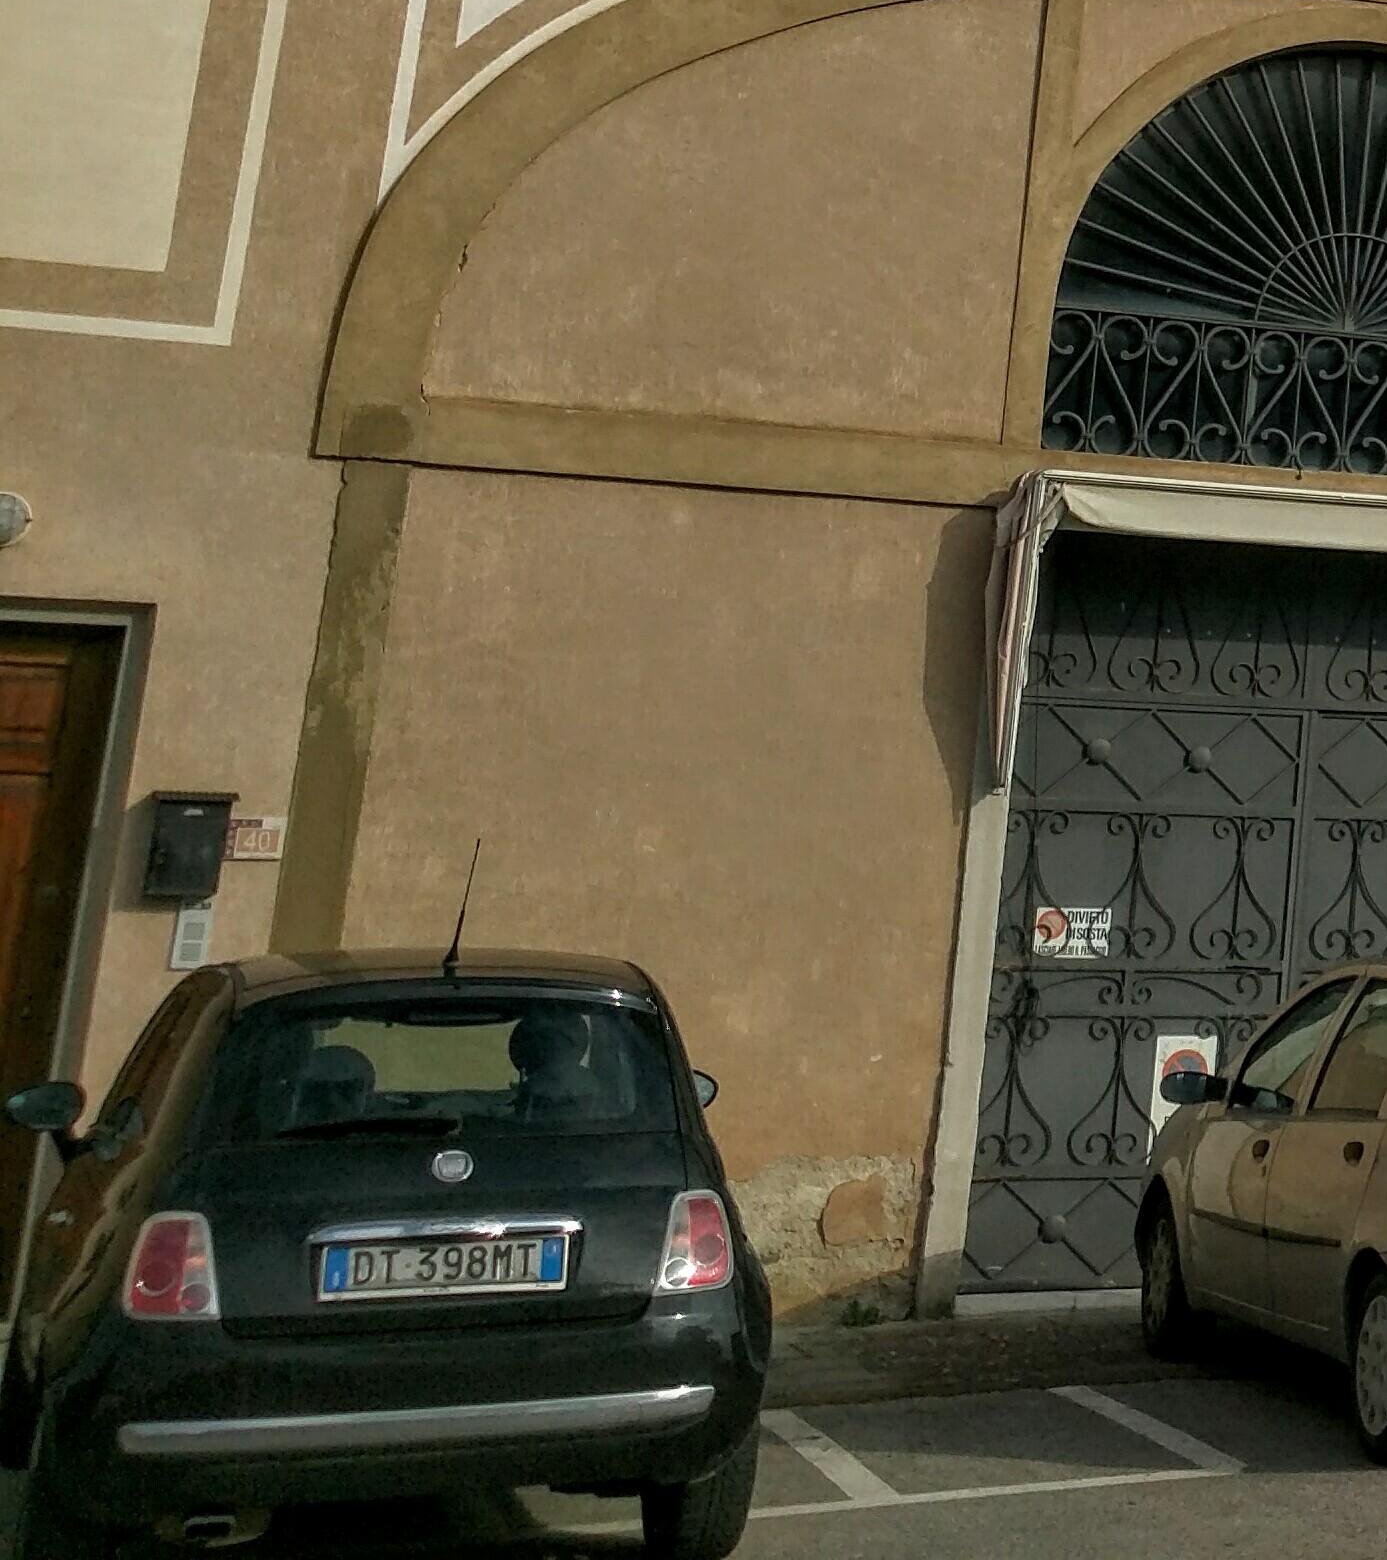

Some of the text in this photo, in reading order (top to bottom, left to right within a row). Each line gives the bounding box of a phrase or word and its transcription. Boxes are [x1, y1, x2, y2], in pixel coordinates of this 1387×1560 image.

[243, 831, 270, 852] 40
[1067, 911, 1109, 924] DIVIETO
[1076, 927, 1107, 940] SOSTA
[353, 1243, 537, 1285] DT 398MT
